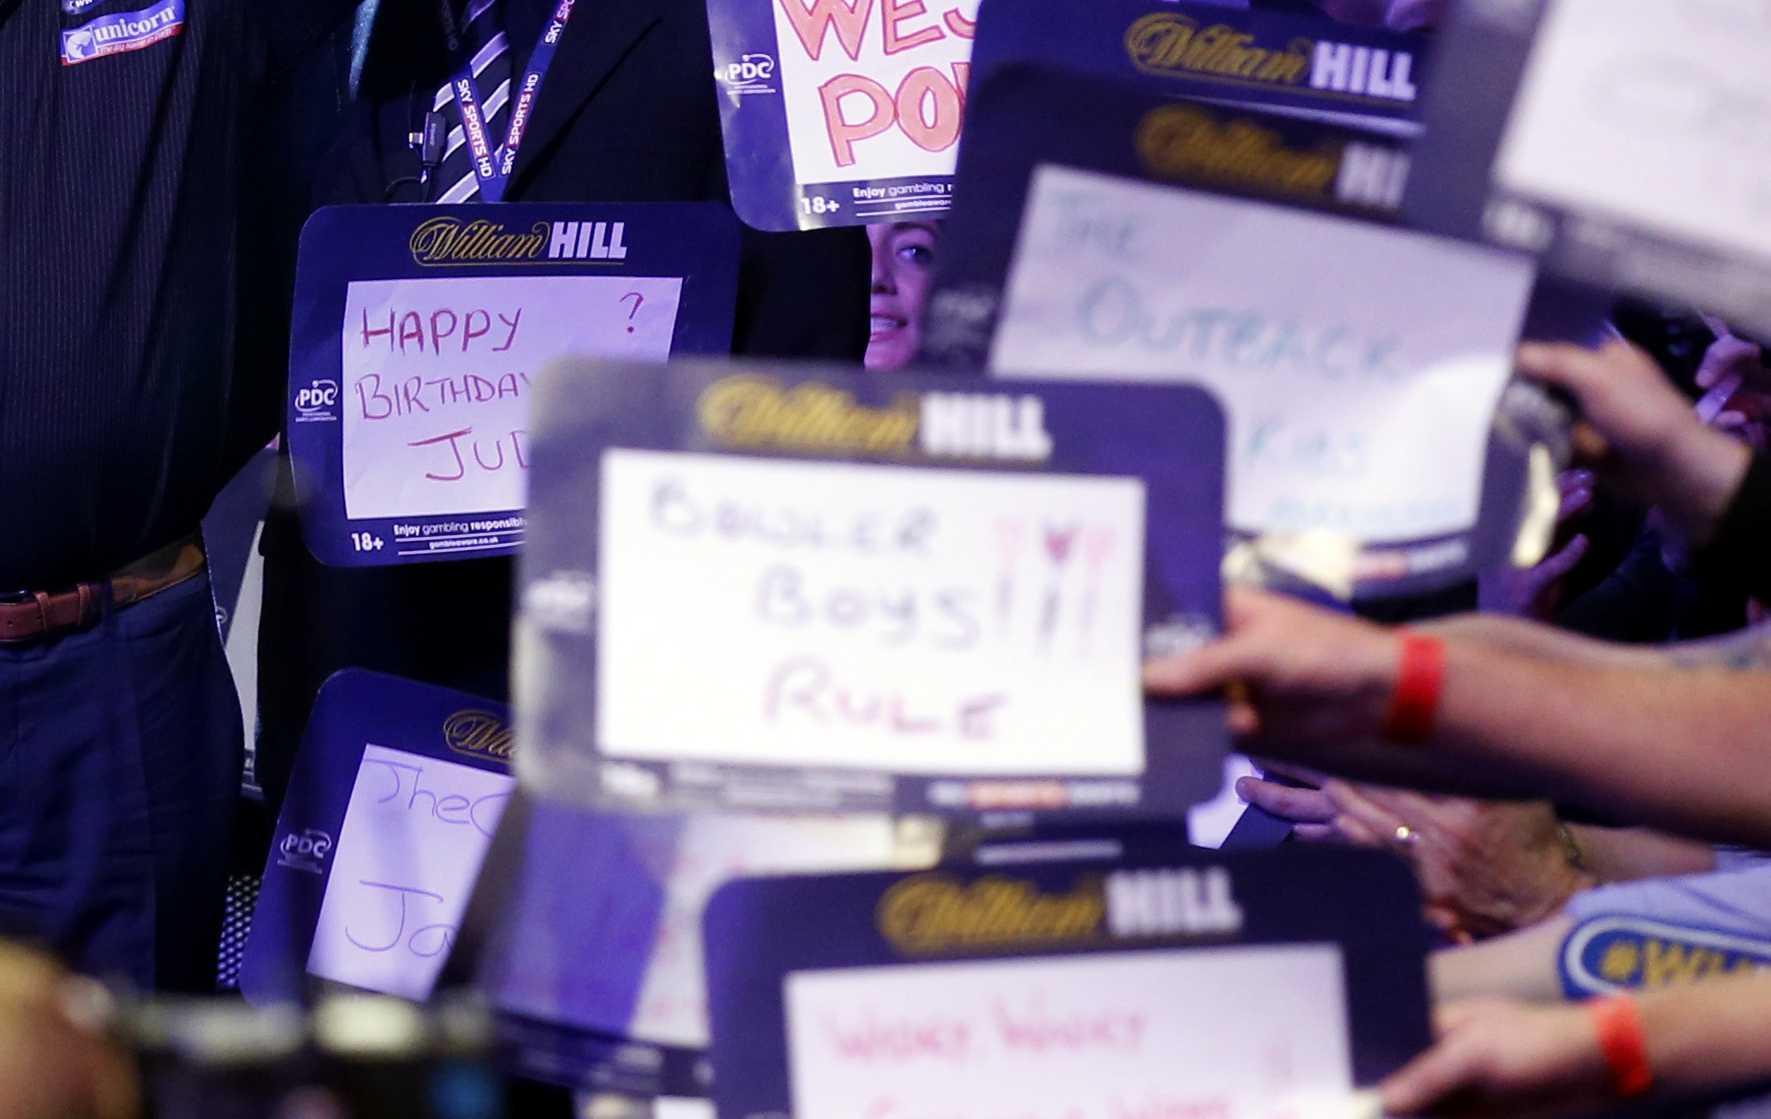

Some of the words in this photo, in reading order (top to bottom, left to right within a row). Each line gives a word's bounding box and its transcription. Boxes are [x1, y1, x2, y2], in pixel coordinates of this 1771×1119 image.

[93, 6, 177, 42] unicorn
[544, 19, 563, 45] SKY
[728, 61, 773, 81] PDC
[1309, 39, 1417, 101] HILL
[457, 78, 474, 103] SKY
[525, 74, 540, 94] HD
[509, 93, 532, 145] SPORTS
[817, 61, 971, 168] PO
[463, 104, 489, 158] SPORTS
[477, 157, 494, 178] HD
[501, 147, 519, 176] SKY
[852, 185, 886, 199] Enjoy
[888, 182, 945, 197] gambling
[799, 196, 840, 215] 18+
[409, 217, 551, 265] William
[548, 221, 628, 259] HILL
[360, 307, 523, 356] HAPPY
[298, 386, 337, 408] PDC
[920, 391, 1052, 460] HILL
[351, 532, 384, 552] 18+
[393, 524, 420, 537] Enjoy
[422, 521, 469, 535] gambling
[1106, 867, 1243, 937] HILL
